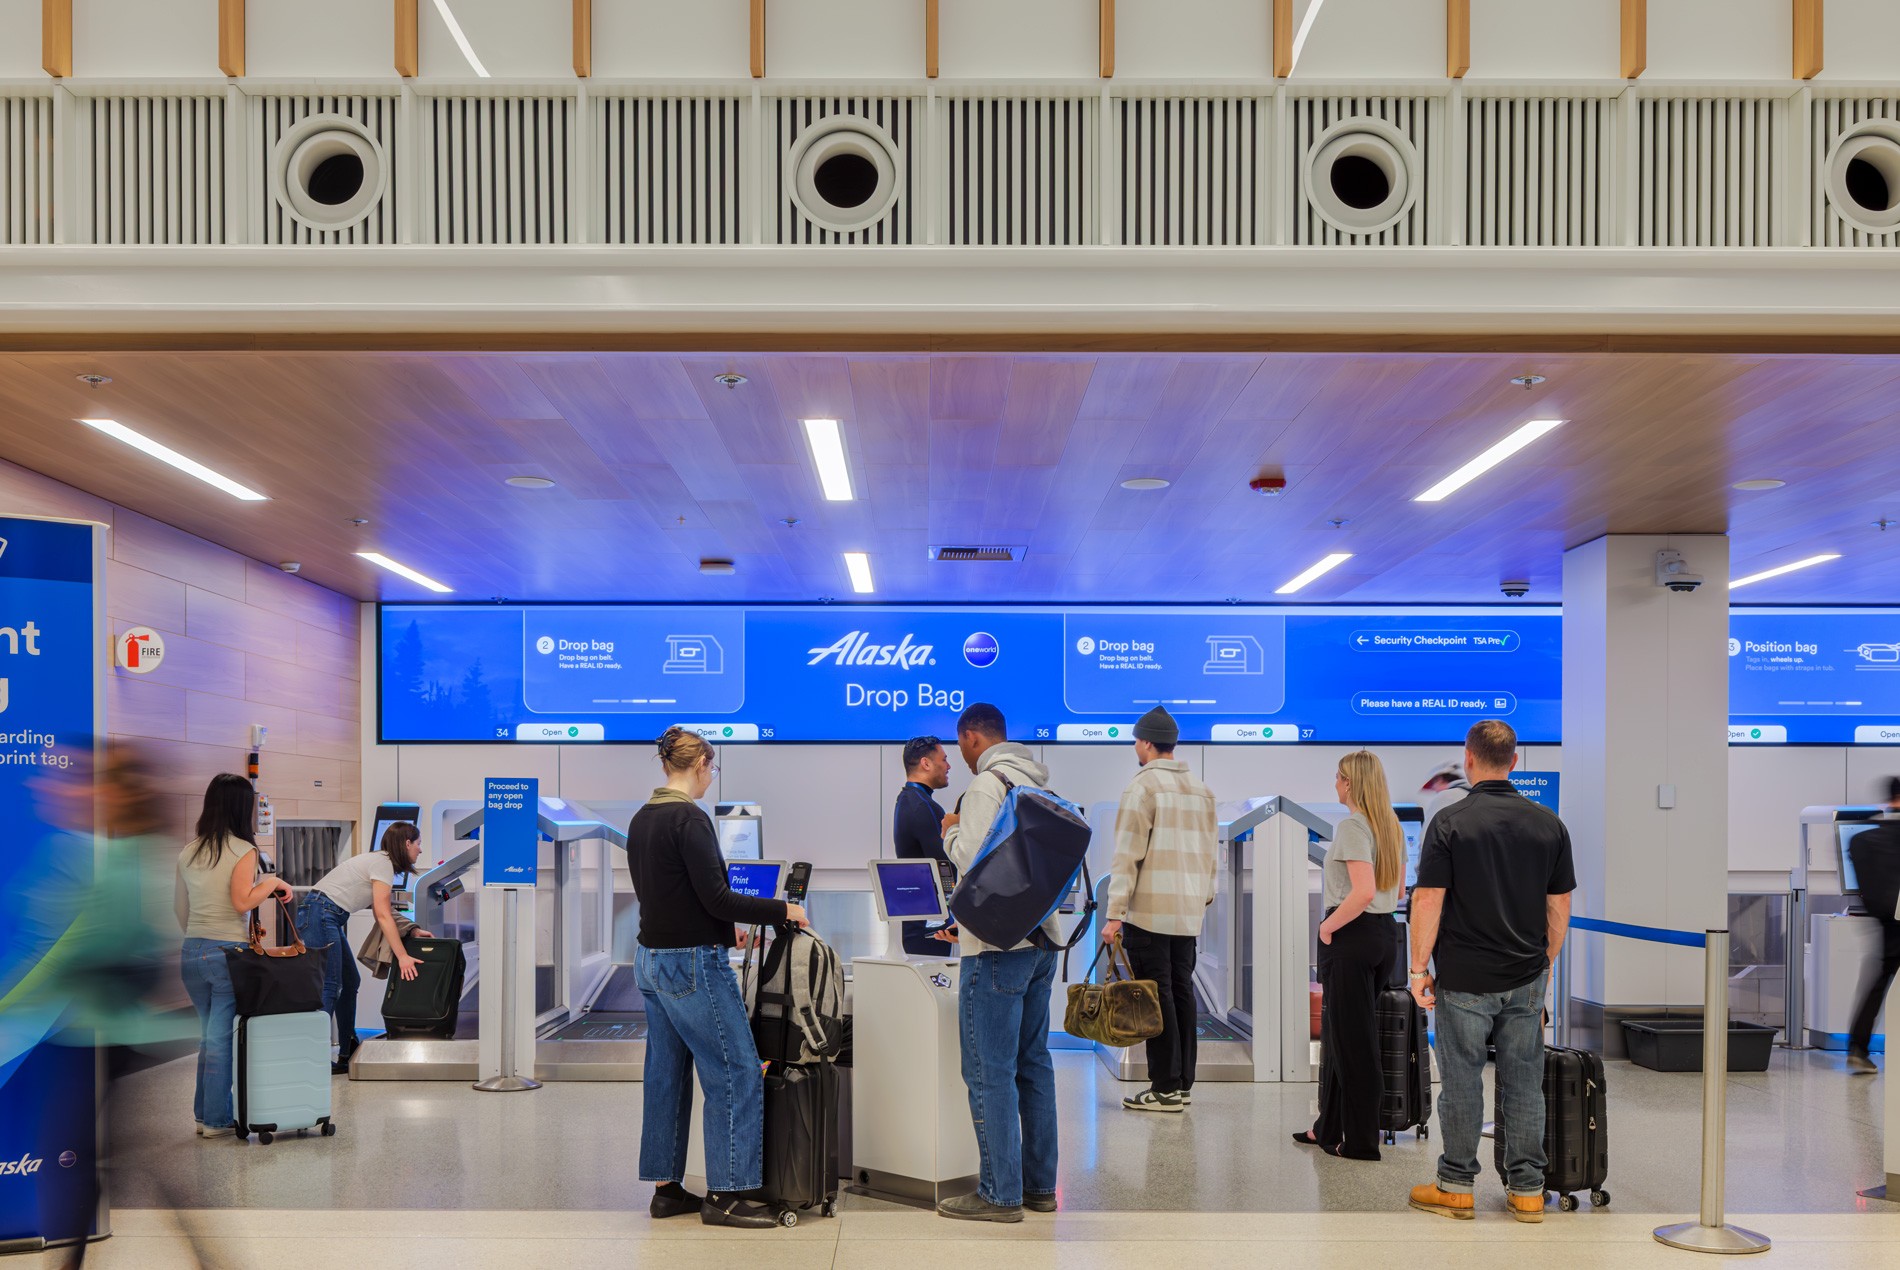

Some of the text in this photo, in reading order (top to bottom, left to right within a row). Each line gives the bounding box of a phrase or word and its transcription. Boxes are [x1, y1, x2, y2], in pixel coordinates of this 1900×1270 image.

[1374, 635, 1412, 646] Security
[1414, 635, 1467, 646] Checkpoint
[1473, 637, 1487, 645] TSA
[558, 639, 588, 653] Drop
[591, 639, 614, 653] bag
[1099, 640, 1129, 653] Drop
[1132, 640, 1154, 653] bag
[1745, 641, 1792, 652] Position
[1795, 641, 1818, 655] bag
[142, 648, 160, 656] FIRE
[846, 683, 965, 712] Drop Bag
[1360, 699, 1390, 708] Please
[1392, 699, 1412, 708] have
[1422, 699, 1446, 708] REAL
[1448, 699, 1458, 708] ID
[1460, 699, 1488, 710] ready.
[496, 728, 509, 737] 34
[542, 728, 562, 737] Open
[697, 728, 717, 736] Open
[761, 728, 774, 737] 35
[1036, 729, 1049, 738] 36
[1082, 729, 1102, 737] Open
[1237, 729, 1257, 737] Open
[1302, 729, 1314, 738] 37
[41, 752, 73, 769] tag.
[488, 801, 522, 810] bag drop
[732, 876, 749, 884] Print
[744, 887, 759, 896] tags
